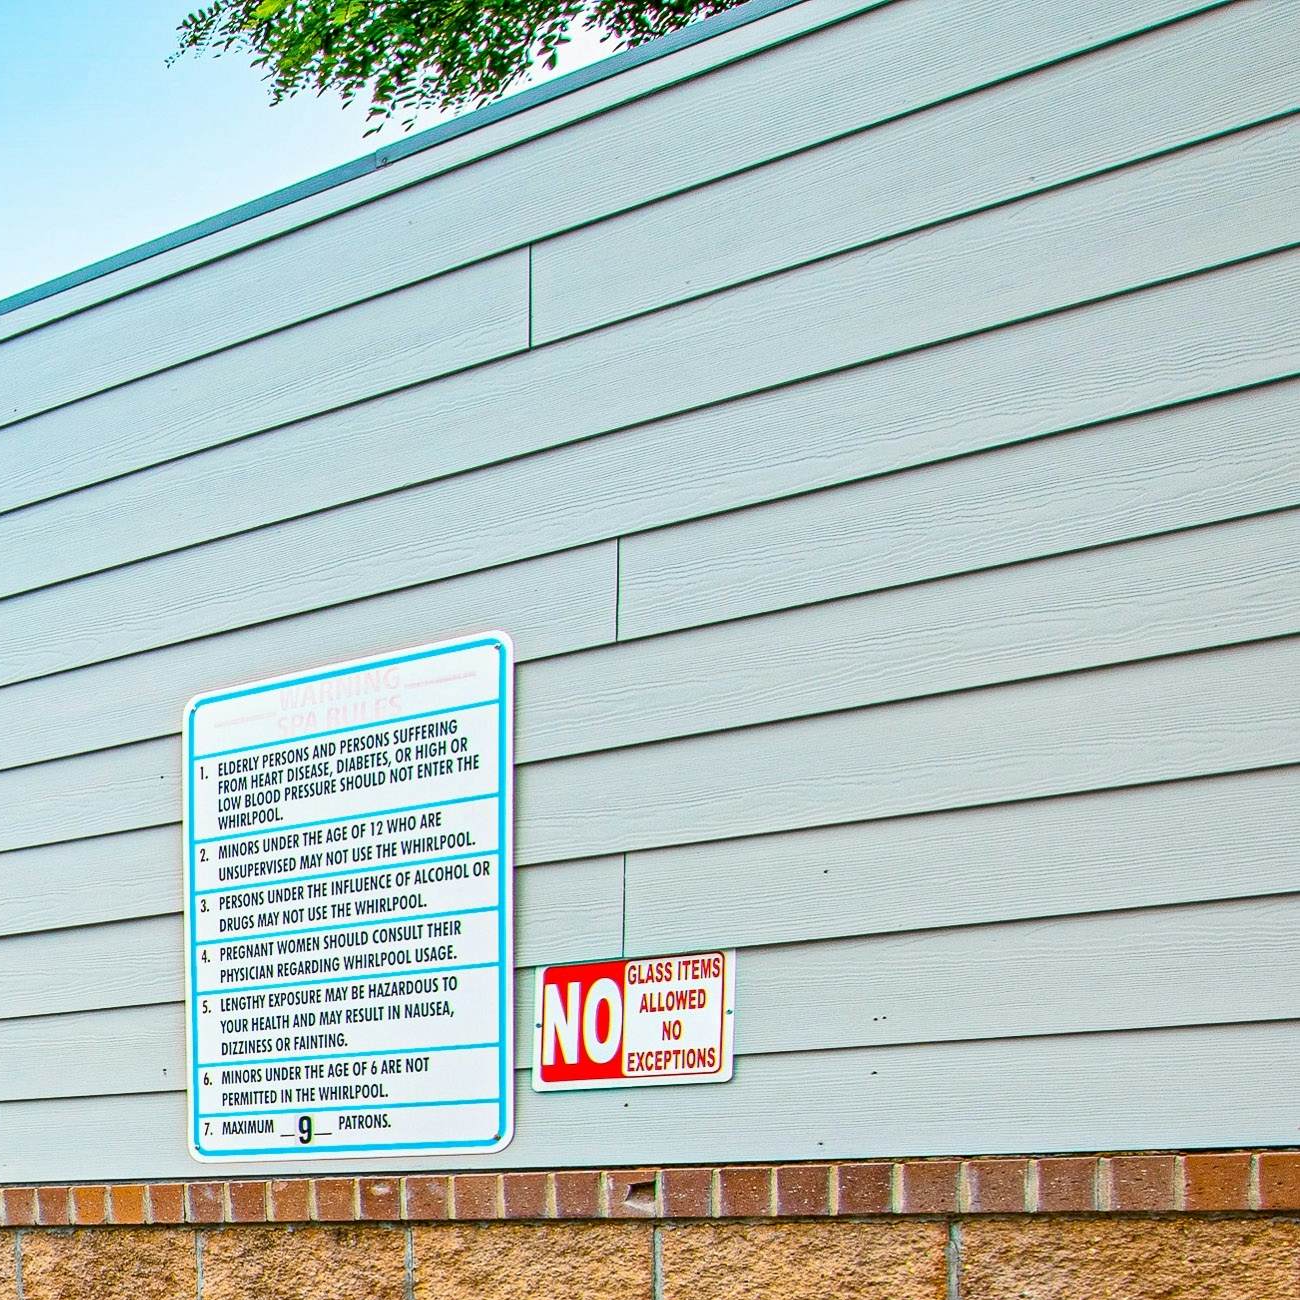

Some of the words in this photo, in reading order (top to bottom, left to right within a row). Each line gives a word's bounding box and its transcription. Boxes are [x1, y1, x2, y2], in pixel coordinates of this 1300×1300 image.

[200, 766, 209, 780] 1.
[218, 755, 260, 777] ELDERLY
[262, 746, 310, 769] PERSONS
[312, 742, 336, 760] AND
[340, 731, 390, 755] PERSONS
[393, 719, 458, 745] SUFFERING
[218, 776, 248, 795] FROM
[250, 769, 284, 790] HEART
[287, 761, 333, 783] DISEASE,
[336, 750, 392, 774] DIABETES,
[395, 747, 412, 764] OR
[415, 740, 447, 760] HIGH
[450, 736, 468, 754] OR
[218, 795, 242, 813] LOW
[244, 788, 281, 808] BLOOD
[284, 778, 337, 802] PRESSURE
[340, 770, 386, 792] SHOULD
[389, 765, 414, 784] NOT
[417, 759, 453, 779] ENTER
[456, 754, 480, 773] THE
[199, 848, 209, 863] 2.
[218, 839, 260, 860] MINORS
[262, 833, 300, 853] UNDER
[302, 829, 323, 847] THE
[325, 825, 348, 844] AGE
[351, 823, 366, 840] OF
[370, 820, 384, 837] 12
[386, 815, 417, 834] WHO
[419, 811, 442, 829] ARE
[217, 807, 284, 831] WHIRLPOOL.
[218, 857, 297, 882] UNSUPERVISED
[299, 852, 323, 870] MAY
[326, 848, 349, 867] NOT
[352, 845, 373, 863] USE
[375, 841, 397, 859] THE
[400, 831, 476, 856] WHIRLPOOL.
[200, 898, 210, 913] 3.
[219, 890, 265, 911] PERSONS
[267, 885, 304, 904] UNDER
[307, 882, 328, 899] THE
[331, 873, 392, 896] INFLUENCE
[395, 870, 411, 887] OF
[413, 863, 470, 885] ALCOHOL
[472, 860, 490, 877] OR
[219, 914, 255, 933] DRUGS
[257, 911, 280, 928] MAY
[282, 908, 305, 925] NOT
[307, 905, 328, 922] USE
[330, 902, 352, 919] THE
[354, 893, 427, 916] WHIRLPOOL.
[201, 949, 211, 964] 4.
[220, 941, 274, 962] PREGNANT
[276, 936, 320, 955] WOMEN
[323, 930, 369, 950] SHOULD
[372, 924, 424, 944] CONSULT
[426, 920, 462, 938] THEIR
[220, 964, 274, 984] PHYSICIAN
[277, 956, 340, 978] REGARDING
[343, 949, 412, 971] WHIRLPOOL
[415, 944, 458, 963] USAGE.
[627, 961, 673, 985] GLASS
[677, 957, 721, 980] ITEMS
[202, 999, 212, 1014] 5.
[220, 994, 266, 1013] LENGTHY
[268, 988, 322, 1008] EXPOSURE
[324, 986, 349, 1003] MAY
[351, 984, 365, 1000] BE
[368, 977, 439, 999] HAZARDOUS
[442, 975, 458, 992] TO
[639, 988, 706, 1014] ALLOWED
[220, 1018, 249, 1034] YOUR
[251, 1014, 290, 1032] HEALTH
[292, 1012, 316, 1028] AND
[319, 1009, 343, 1026] MAY
[345, 1006, 385, 1024] RESULT
[388, 1004, 401, 1020] IN
[404, 1000, 455, 1019] NAUSEA,
[542, 977, 623, 1066] NO
[661, 1019, 682, 1041] NO
[221, 1038, 273, 1056] DIZZINESS
[275, 1037, 291, 1052] OR
[293, 1032, 348, 1051] FAINTING.
[626, 1047, 716, 1072] EXCEPTIONS
[203, 1072, 213, 1086] 6.
[221, 1068, 263, 1085] MINORS
[265, 1066, 302, 1082] UNDER
[304, 1064, 325, 1080] THE
[327, 1062, 350, 1078] AGE
[352, 1061, 368, 1077] OF
[370, 1060, 378, 1075] 6
[380, 1058, 402, 1075] ARE
[405, 1056, 430, 1073] NOT
[222, 1089, 278, 1107] PERMITTED
[281, 1088, 293, 1104] IN
[295, 1087, 316, 1103] THE
[318, 1083, 389, 1101] WHIRLPOOL.
[204, 1122, 213, 1137] 7.
[222, 1119, 274, 1136] MAXIMUM
[338, 1113, 393, 1131] PATRONS.
